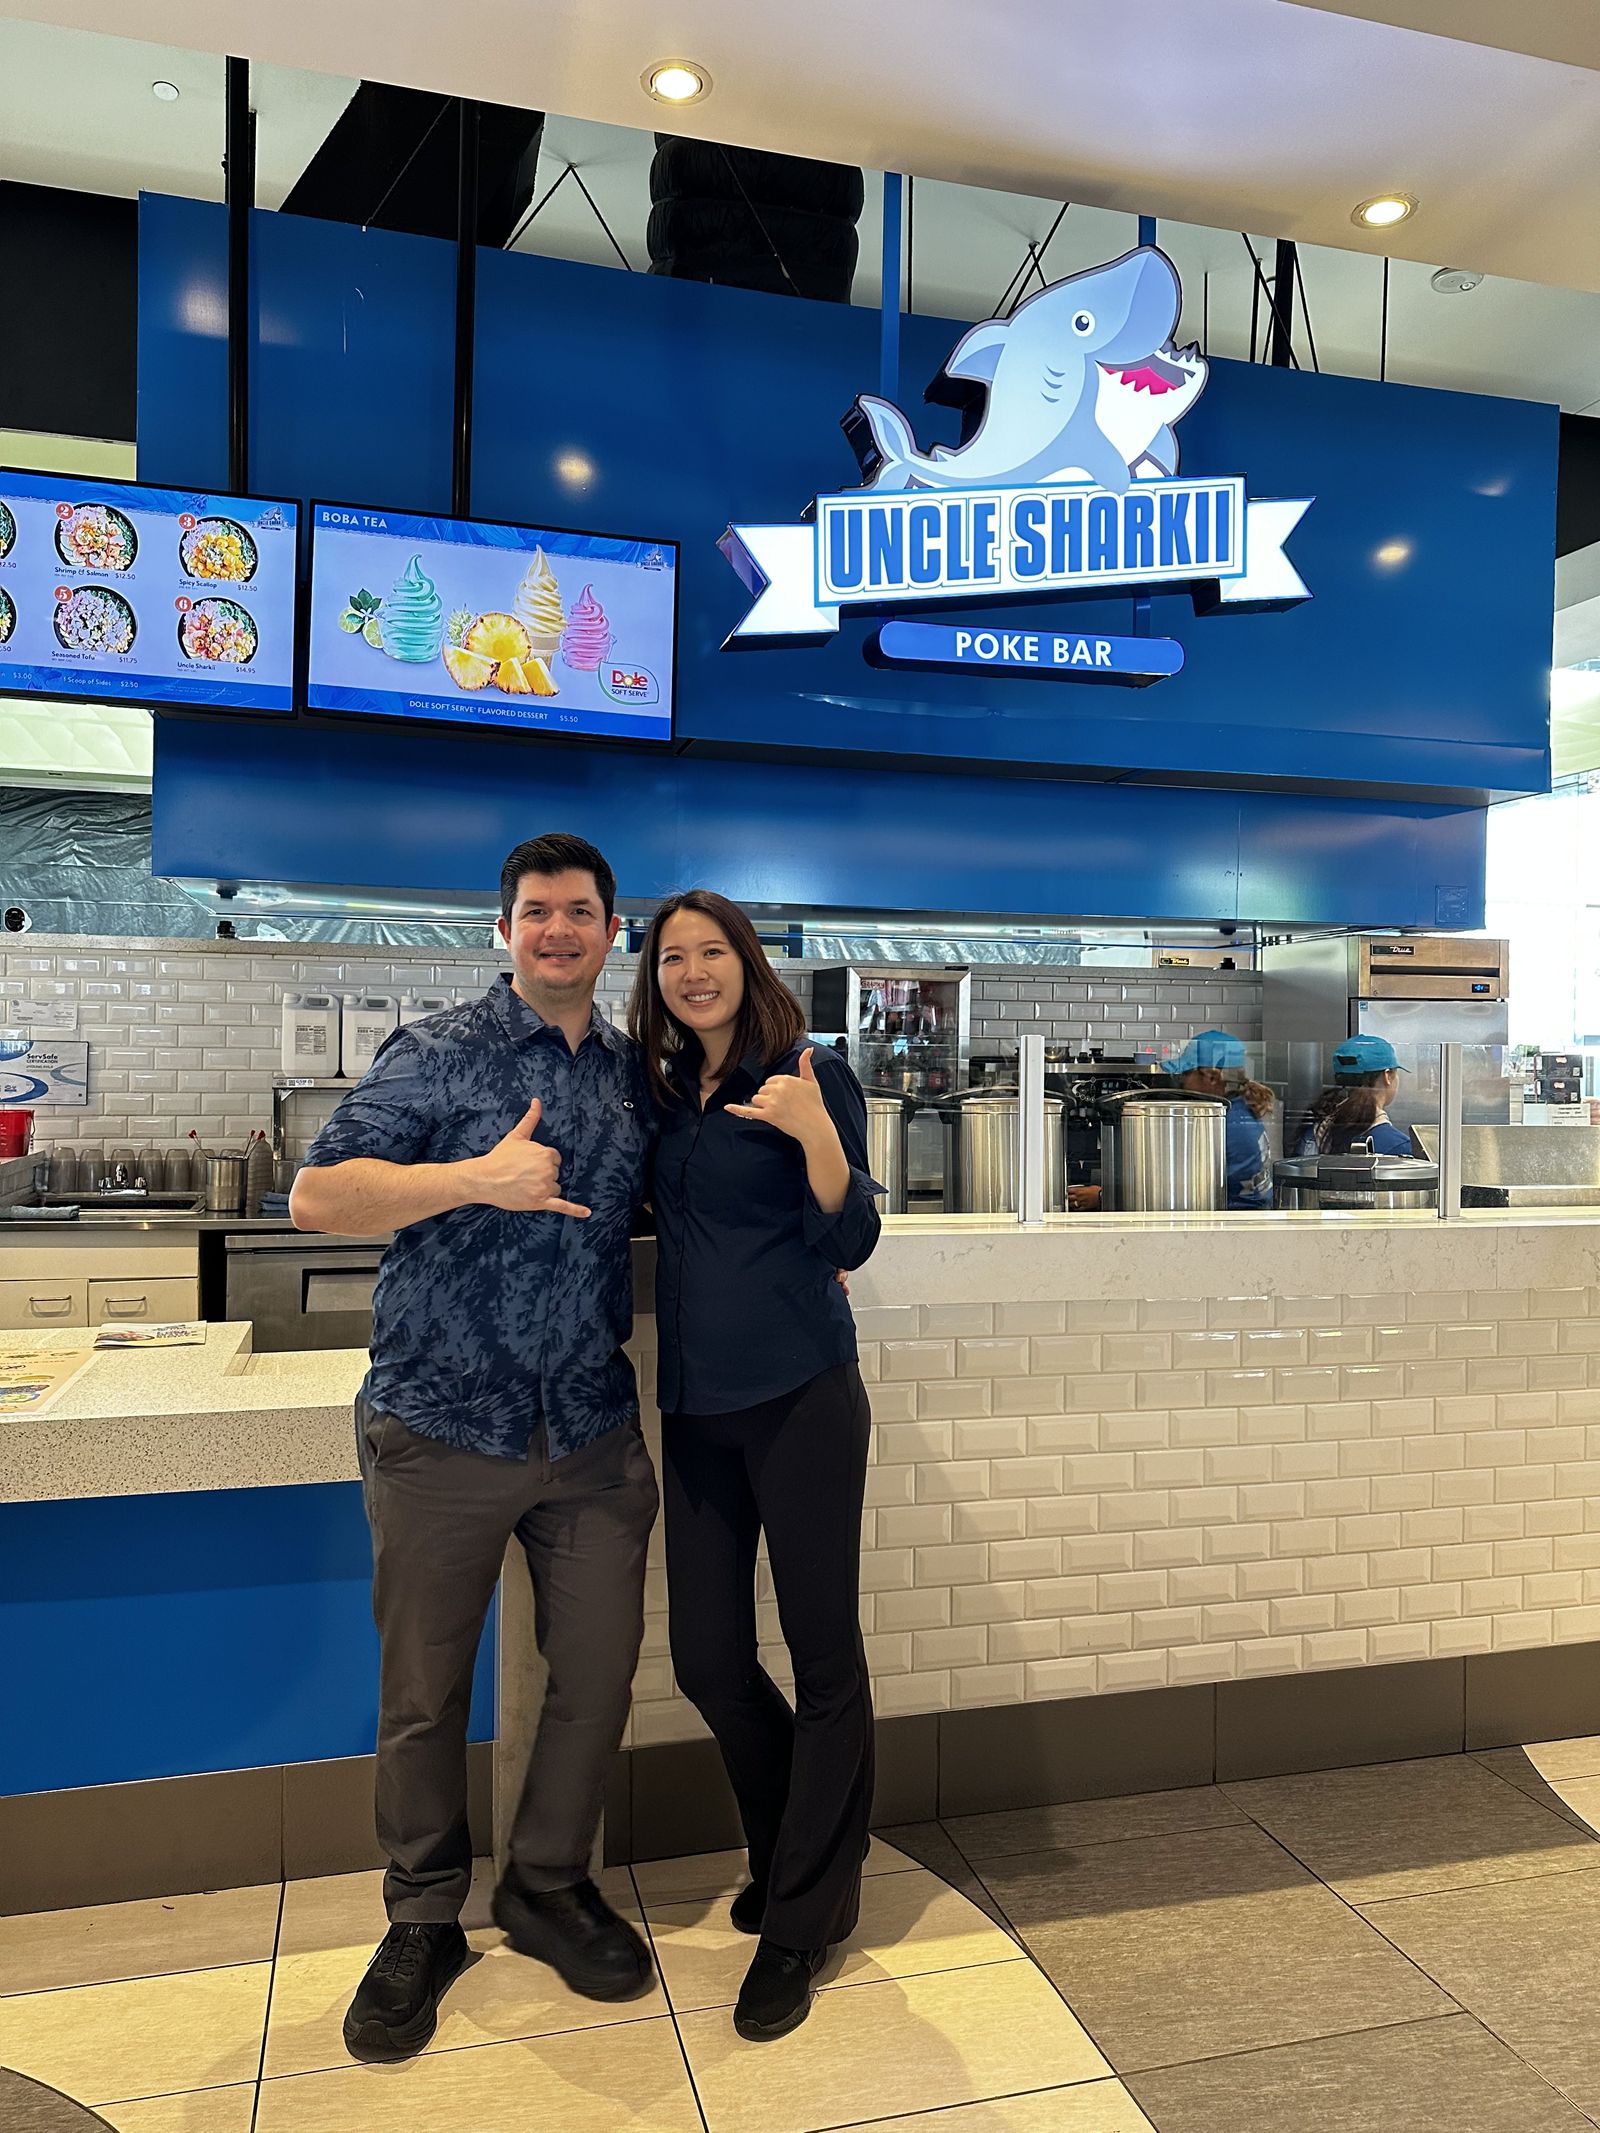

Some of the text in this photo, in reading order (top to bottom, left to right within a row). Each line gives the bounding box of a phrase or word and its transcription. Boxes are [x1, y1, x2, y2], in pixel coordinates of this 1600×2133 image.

[59, 504, 70, 516] 2
[182, 515, 193, 528] 3
[322, 511, 388, 529] BOBA TEA
[829, 490, 1231, 588] UNCLE SHARKII
[54, 566, 77, 576] Shrimp
[86, 569, 109, 578] Salmon
[115, 572, 136, 580] $12.50
[179, 578, 195, 588] Spicy
[196, 580, 217, 590] Scallop
[237, 584, 258, 592] $12.50
[59, 589, 69, 600] 5
[178, 599, 189, 611] 6
[955, 631, 1113, 667] POKE BAR
[51, 650, 81, 659] Seasoned
[81, 653, 96, 661] Tofu
[118, 656, 138, 664] $11.75
[177, 661, 194, 669] Uncle
[194, 662, 216, 671] Sharkii
[13, 671, 33, 680] $3.00
[67, 676, 86, 686] Scoop
[120, 680, 139, 688] $2.50
[611, 669, 649, 687] Dole
[611, 688, 648, 698] SOFT SERVE
[409, 700, 430, 709] DOLE
[430, 702, 450, 711] SOFT
[477, 707, 517, 718] FLAVORED
[517, 711, 549, 720] DESSERT
[559, 714, 579, 723] $5.50
